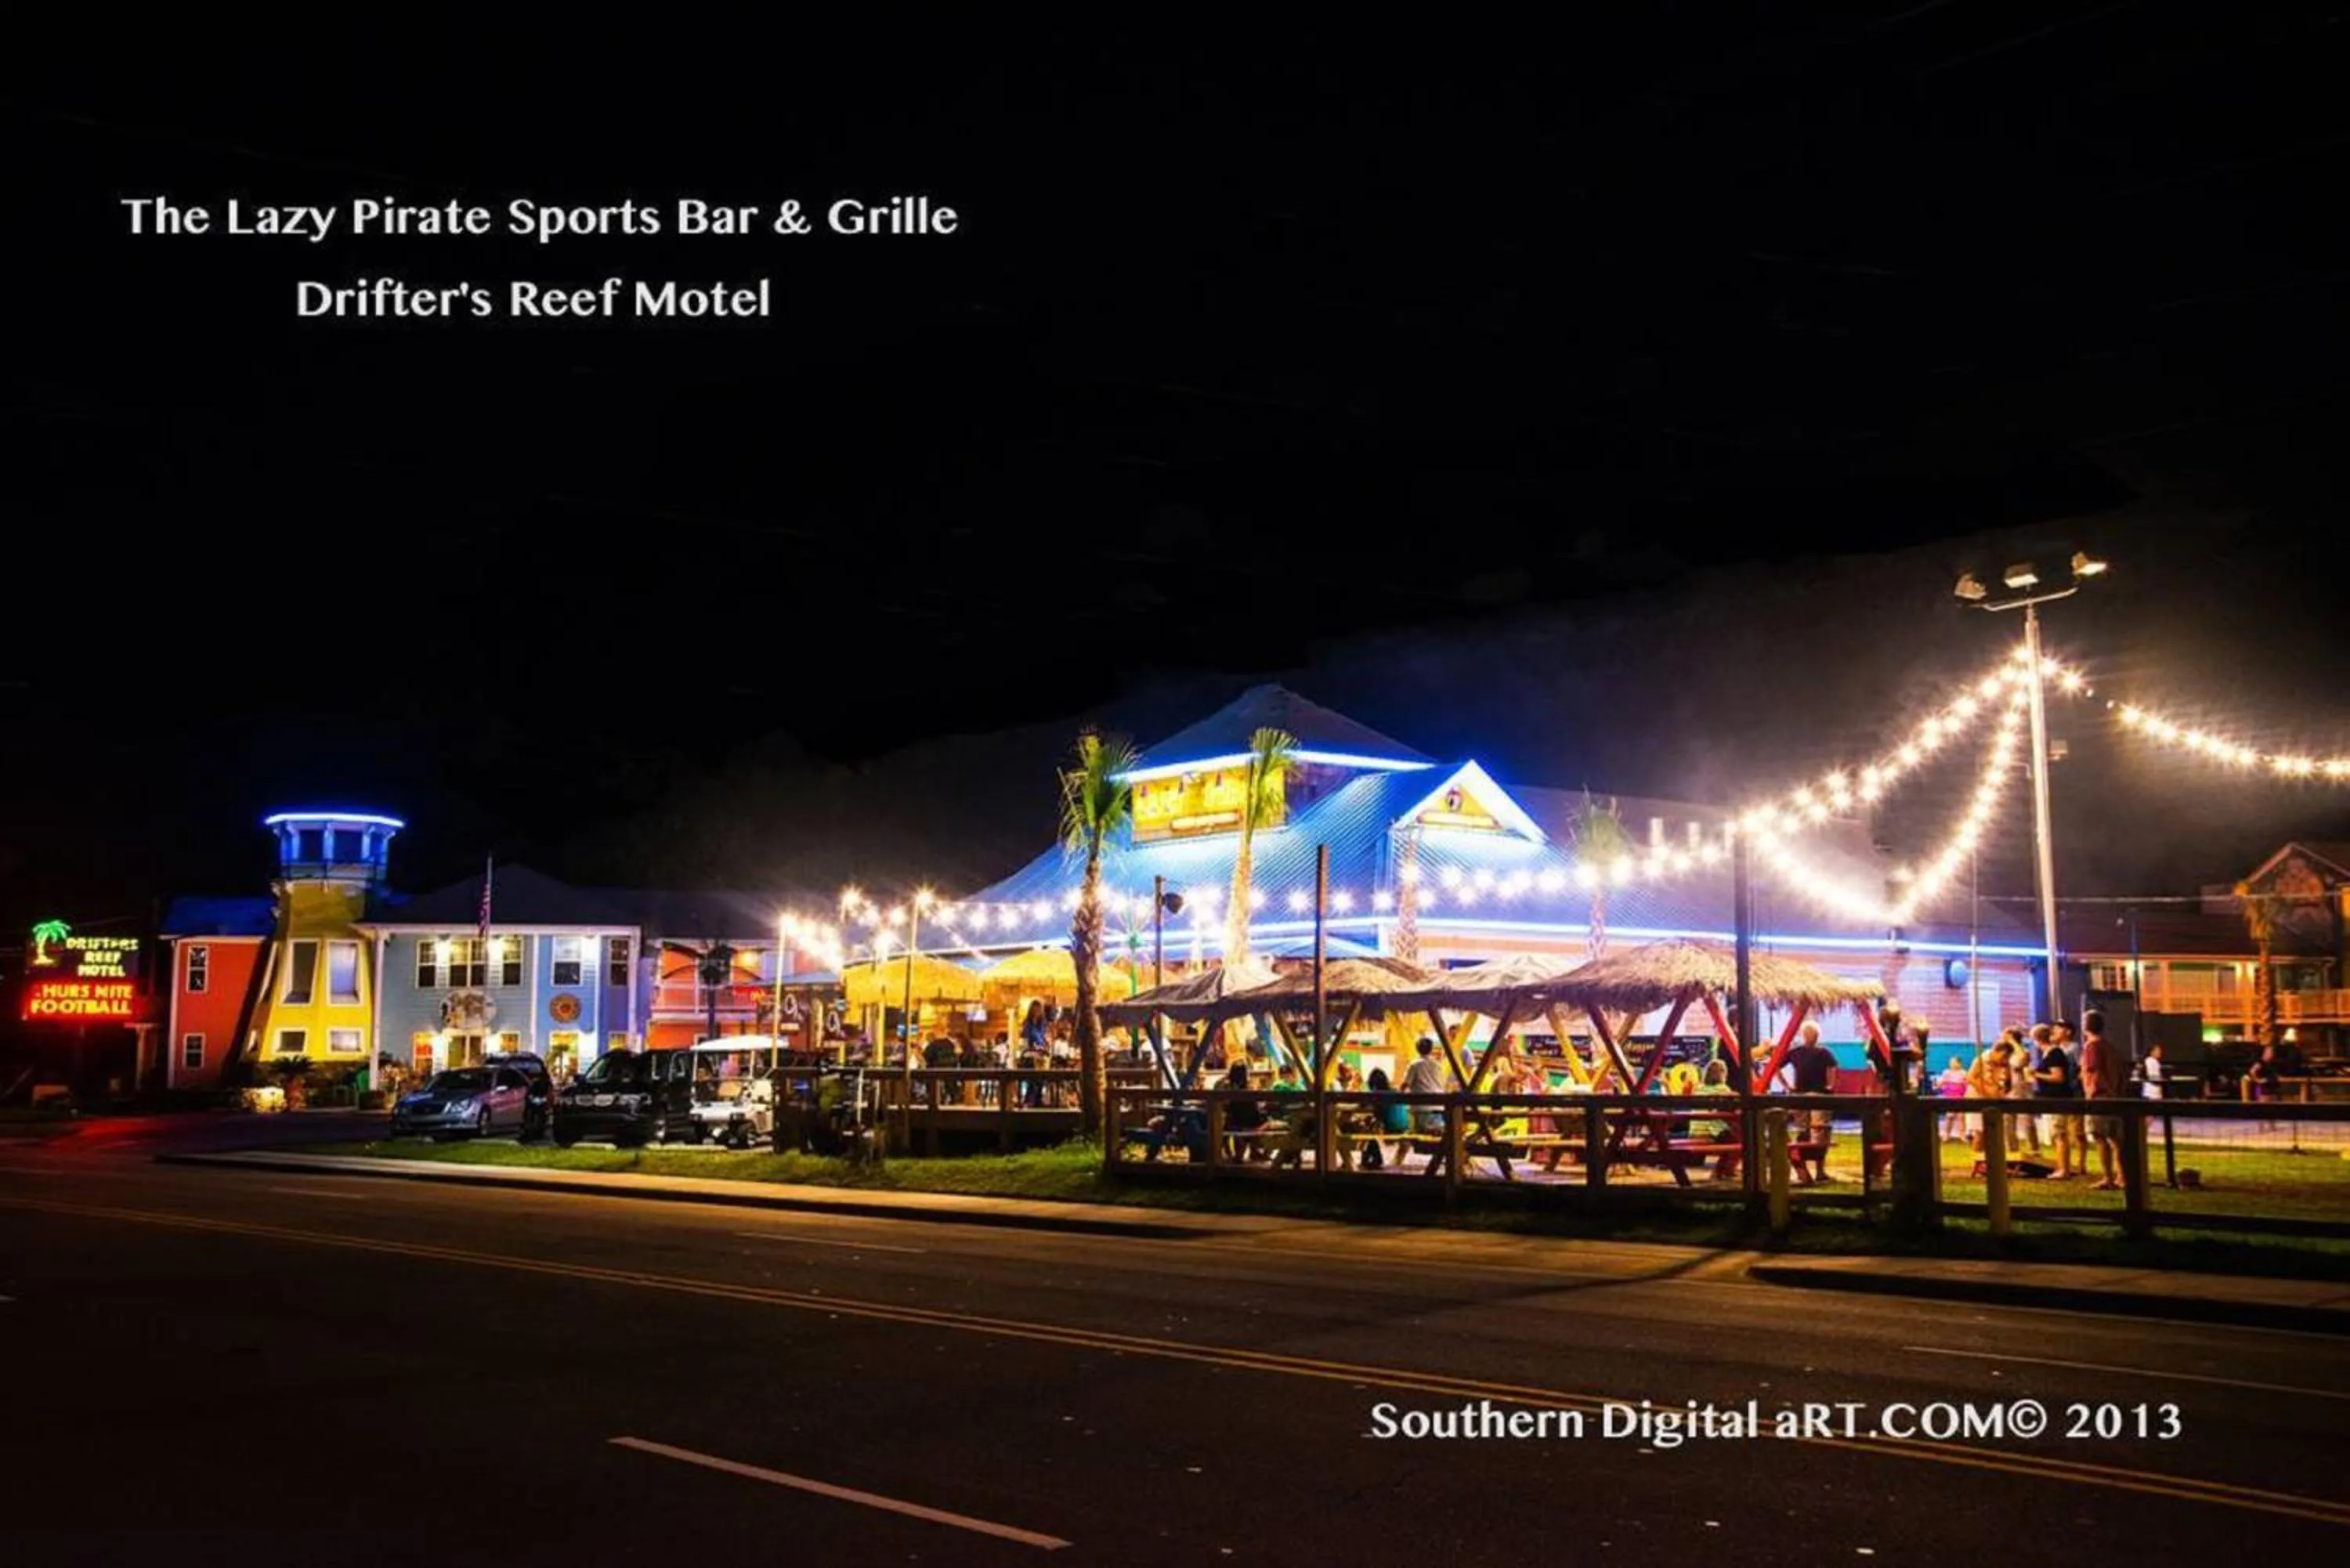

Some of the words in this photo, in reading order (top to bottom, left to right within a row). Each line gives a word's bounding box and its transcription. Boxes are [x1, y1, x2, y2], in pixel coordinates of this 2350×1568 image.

[84, 951, 121, 963] REEF
[78, 964, 125, 977] MOTEL
[95, 985, 132, 998] NITE
[31, 999, 132, 1013] FOOTBALL
